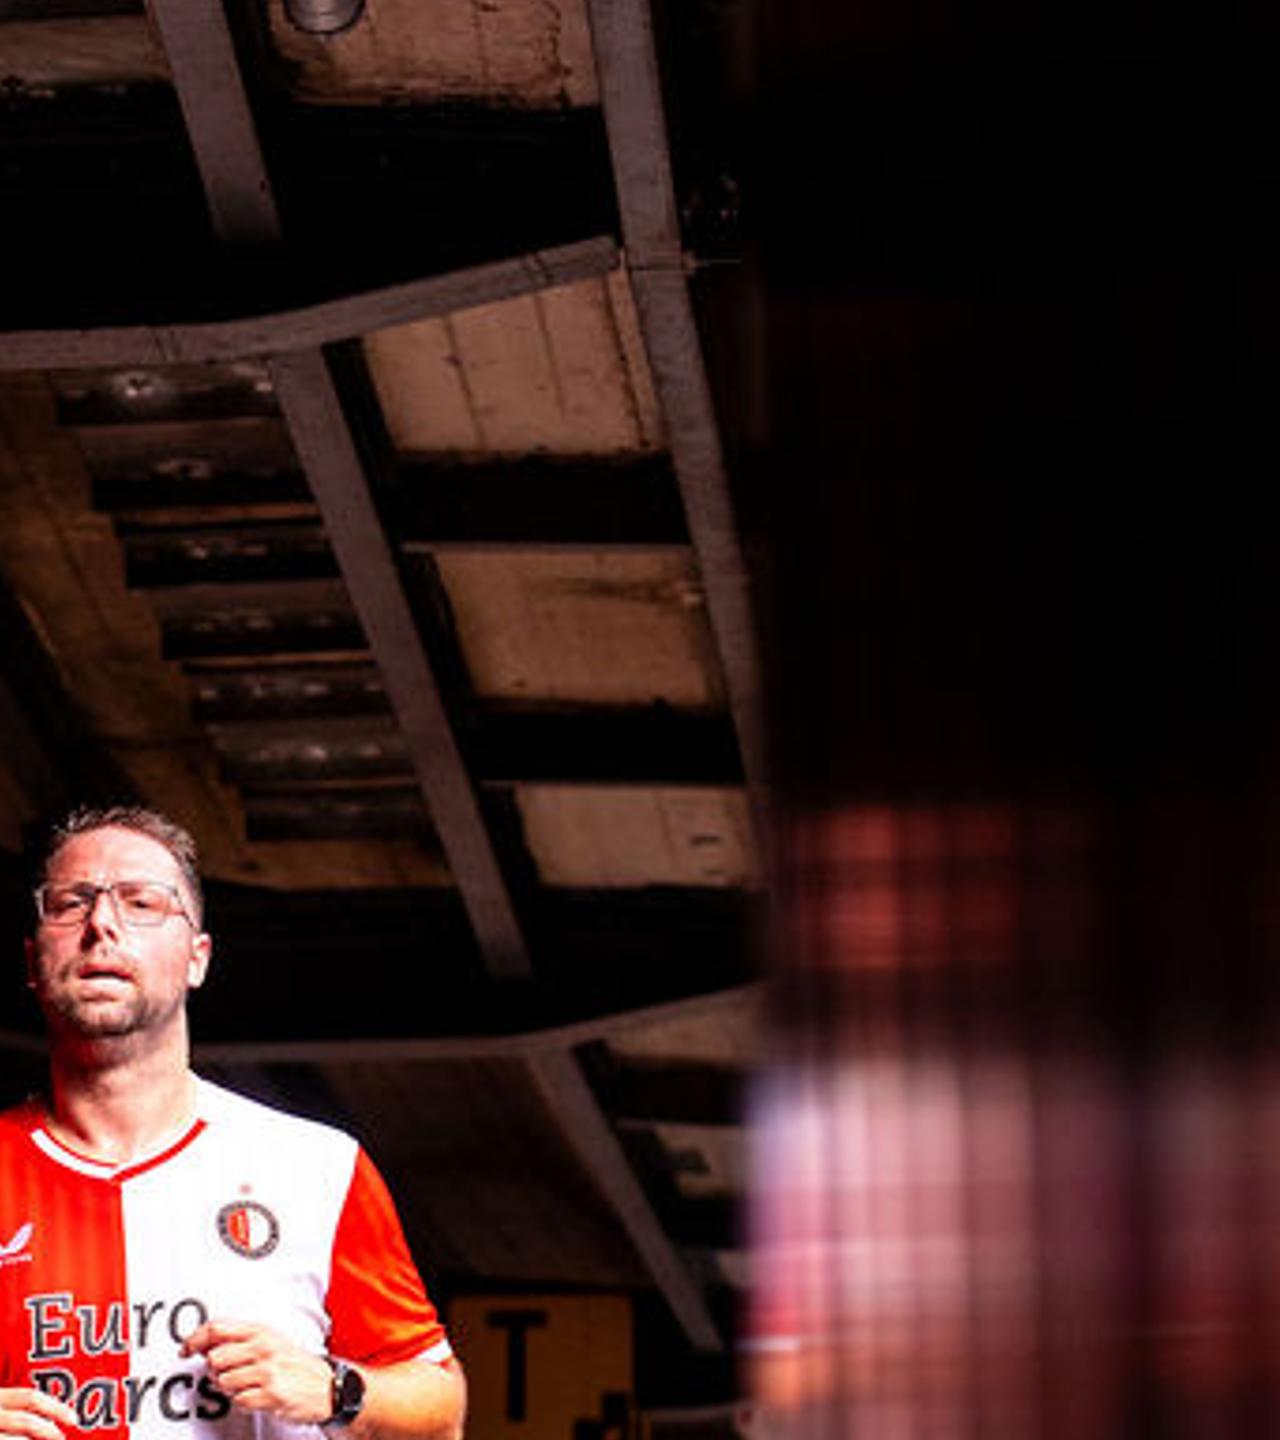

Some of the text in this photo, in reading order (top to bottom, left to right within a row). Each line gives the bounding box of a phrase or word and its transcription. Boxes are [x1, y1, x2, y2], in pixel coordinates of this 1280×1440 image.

[25, 1292, 208, 1361] Euro
[31, 1368, 232, 1430] Parcs
[488, 1311, 546, 1421] T
